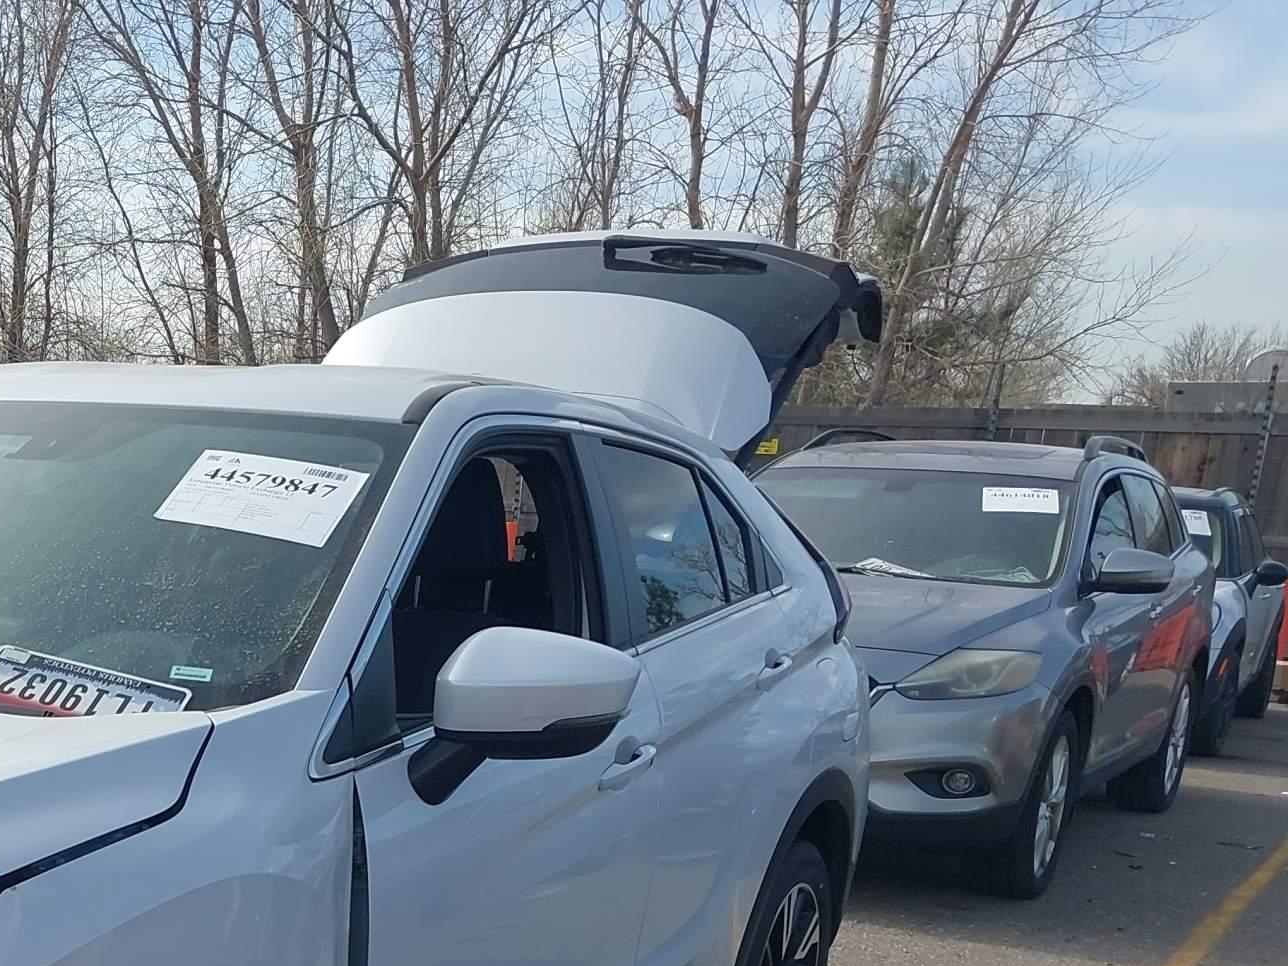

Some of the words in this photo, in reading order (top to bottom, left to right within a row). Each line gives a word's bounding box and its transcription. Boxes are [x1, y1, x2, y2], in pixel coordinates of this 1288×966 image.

[204, 467, 338, 498] 44579847
[42, 657, 97, 678] POTATOES
[99, 671, 142, 688] FAMOUS
